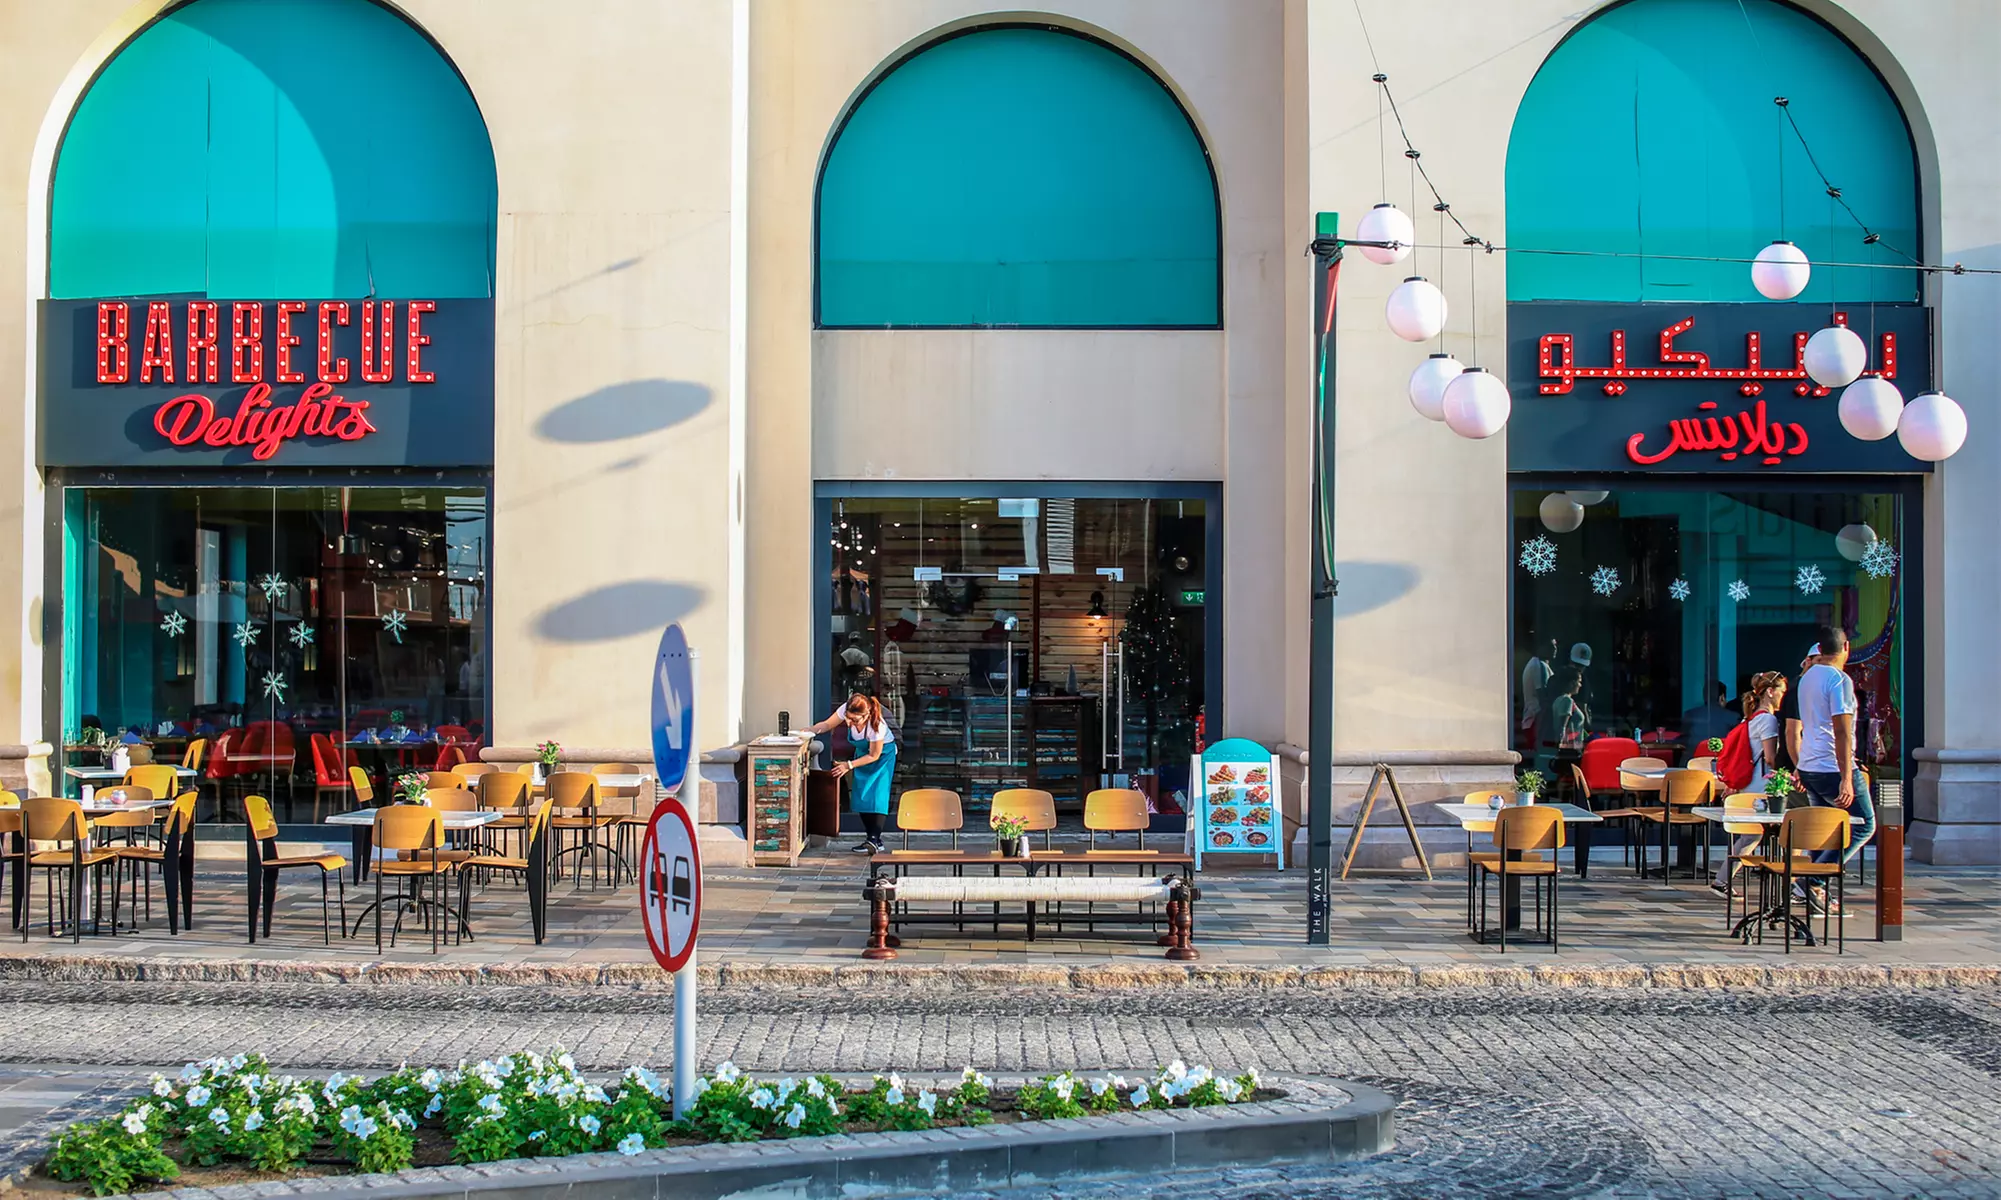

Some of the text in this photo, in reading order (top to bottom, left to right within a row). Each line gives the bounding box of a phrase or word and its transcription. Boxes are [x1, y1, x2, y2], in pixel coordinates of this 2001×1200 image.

[97, 301, 436, 383] BARBECUE
[1539, 312, 1896, 395] بيكيو
[153, 383, 377, 460] Delights
[1626, 400, 1808, 464] ديلايتس
[1313, 867, 1322, 933] THE WALK
